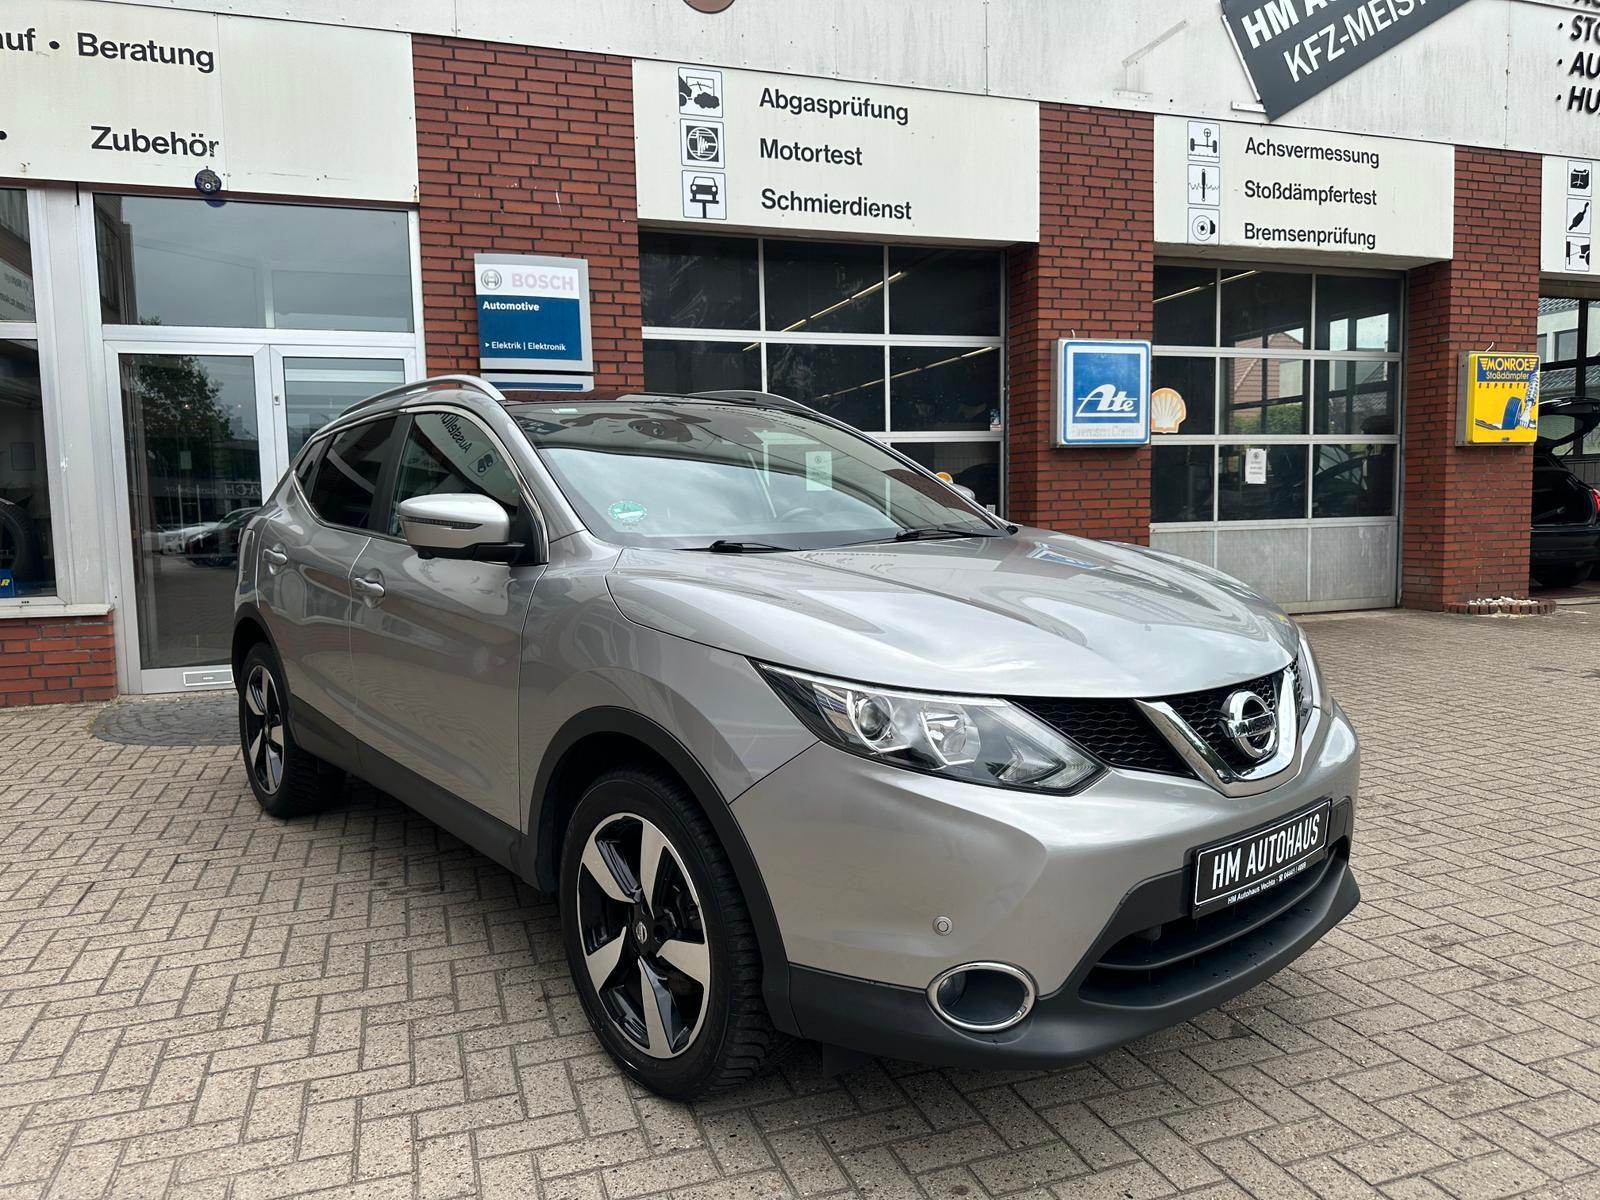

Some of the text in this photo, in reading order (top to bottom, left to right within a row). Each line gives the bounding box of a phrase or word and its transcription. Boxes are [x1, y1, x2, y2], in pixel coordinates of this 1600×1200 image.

[1241, 0, 1299, 49] HM
[0, 27, 215, 74] uf Beratung
[1283, 0, 1426, 83] KFZ-MEIS
[759, 87, 909, 126] Abgasprüfung
[1566, 86, 1600, 116] HU
[91, 125, 220, 158] Zubehör
[759, 137, 863, 166] Motortest
[1244, 136, 1380, 169] Achsvermessung
[761, 187, 912, 220] Schmierdienst
[1244, 179, 1378, 206] Stoßdämpfertest
[1244, 222, 1377, 250] Bremsenprüfung
[511, 272, 574, 291] BOSCH
[482, 300, 540, 312] Automotive
[491, 341, 522, 350] Elektrik
[527, 342, 566, 351] Elektronik
[1486, 357, 1530, 371] MONROE
[1211, 813, 1320, 890] HM AUTOHAUS
